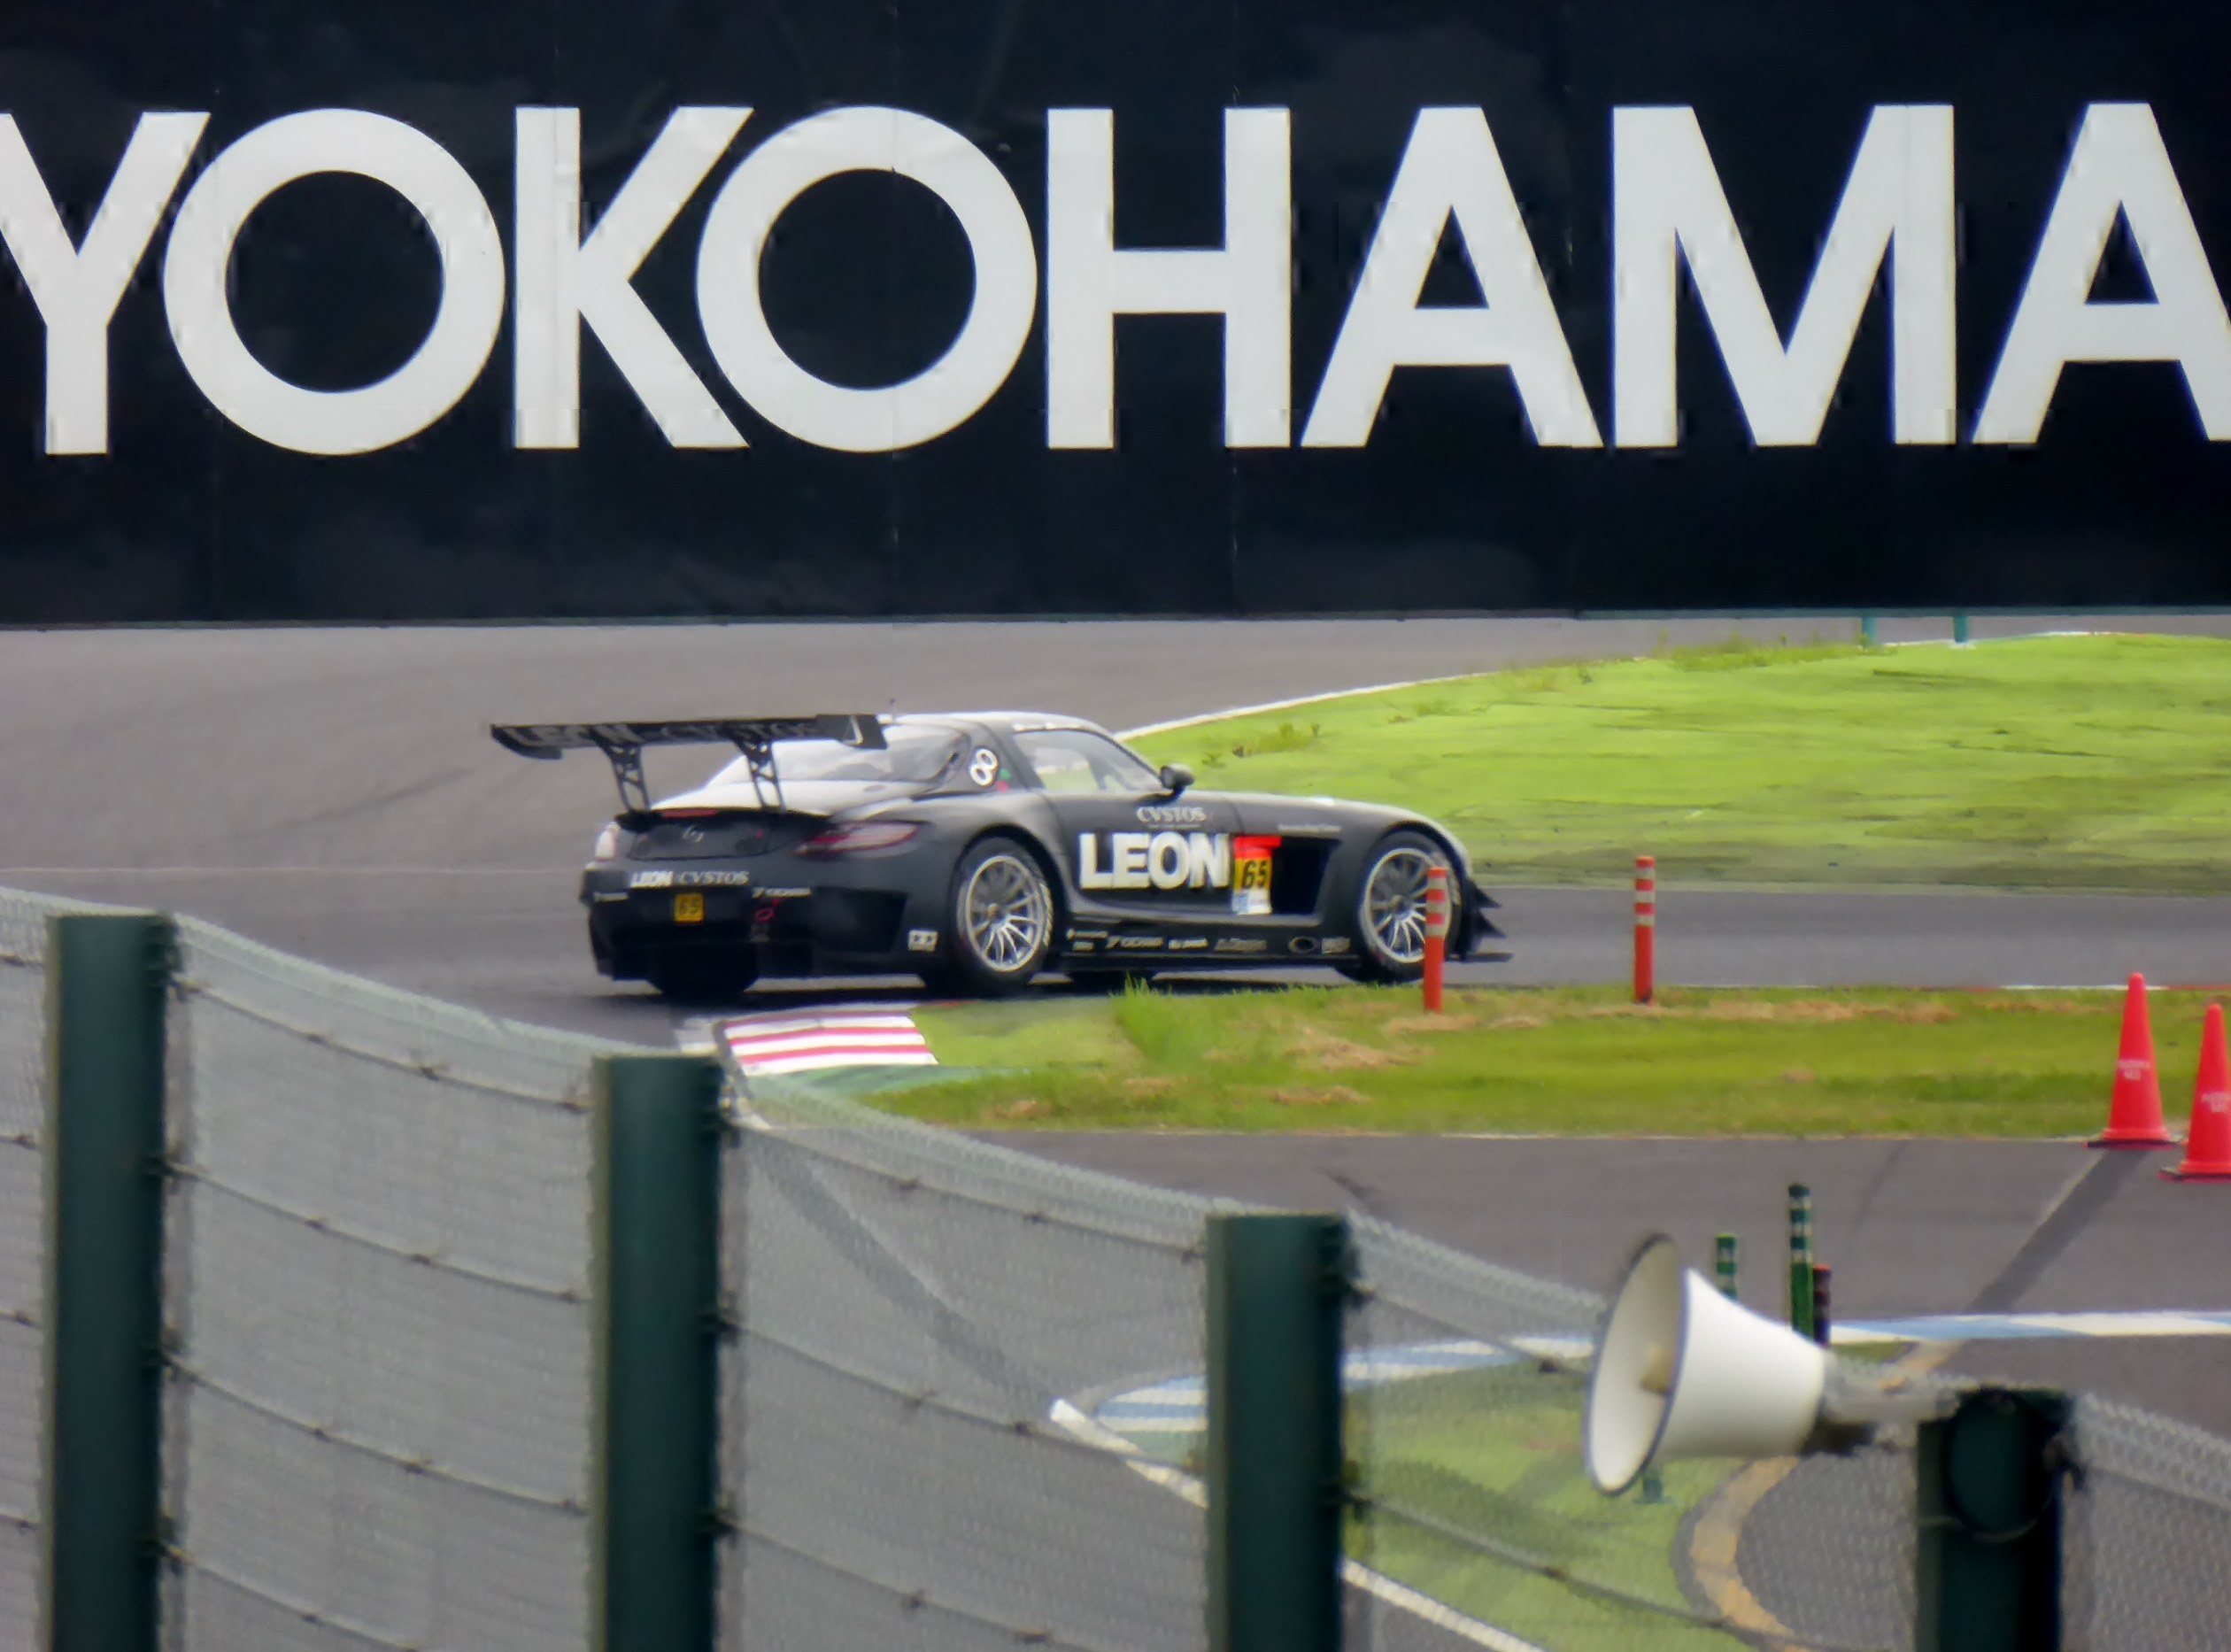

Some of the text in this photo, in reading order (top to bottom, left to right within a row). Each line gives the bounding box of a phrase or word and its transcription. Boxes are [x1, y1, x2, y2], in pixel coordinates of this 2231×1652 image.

[0, 102, 2231, 456] YOKOHAMA
[1078, 831, 1230, 890] LEON
[1241, 860, 1268, 888] 65
